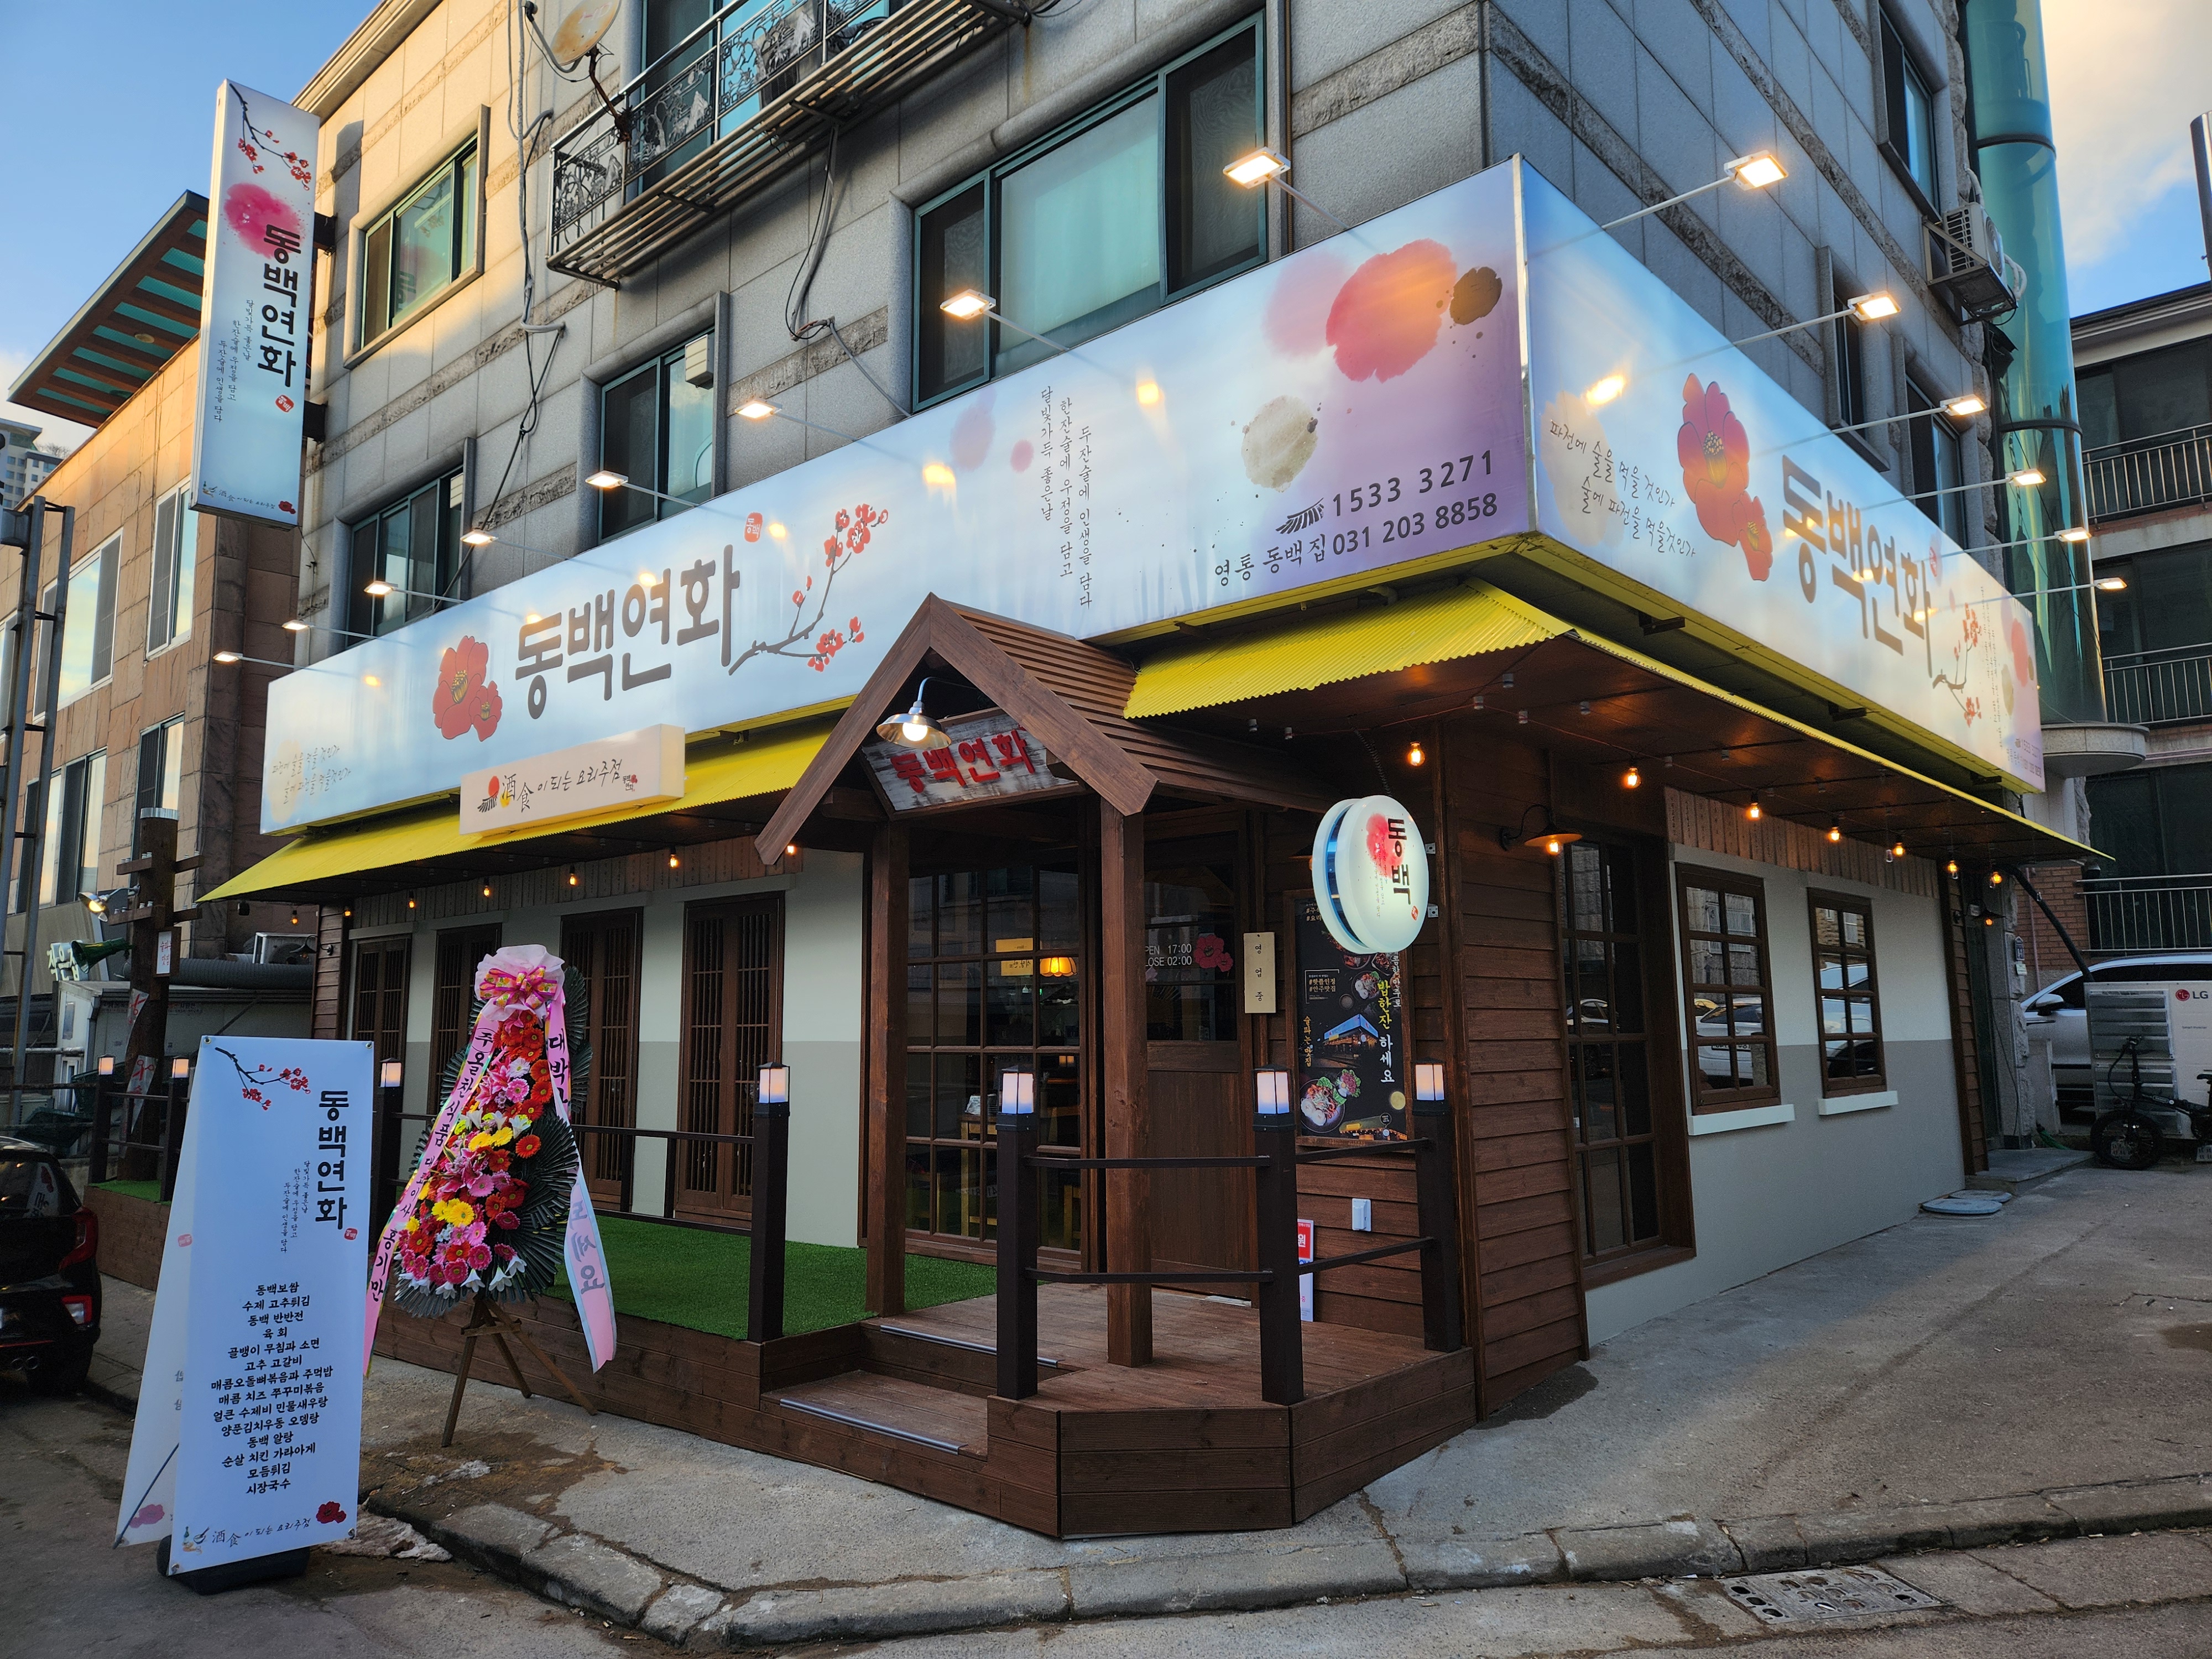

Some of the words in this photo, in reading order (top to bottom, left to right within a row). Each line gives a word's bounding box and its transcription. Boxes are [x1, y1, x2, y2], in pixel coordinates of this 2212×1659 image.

[244, 299, 254, 333] 달빛가득
[257, 223, 302, 388] 동백연화
[231, 320, 241, 353] 한잔술에
[243, 336, 253, 361] 좋은날
[217, 340, 227, 374] 두잔술에
[228, 356, 238, 382] 우정을
[215, 377, 223, 403] 인생을
[228, 384, 237, 401] 담고
[214, 405, 223, 422] 담다
[1041, 385, 1053, 458] 달빛가득
[1060, 397, 1072, 471] 한잔술에
[1078, 426, 1092, 501] 두잔술에
[1550, 419, 1587, 453] 파전에
[1593, 441, 1614, 483] 술을
[1619, 461, 1639, 499] 먹을
[1645, 474, 1675, 508] 것인가
[1041, 466, 1053, 521] 좋은날
[1333, 477, 1401, 517] 1533
[1419, 450, 1491, 494] 3271
[1060, 479, 1072, 535] 우정을
[1582, 476, 1603, 514] 술에
[1609, 498, 1641, 539] 파전을
[746, 518, 761, 539] 동백
[1079, 509, 1092, 565] 인생을
[1333, 526, 1370, 555] 031
[1383, 512, 1425, 543] 203
[1435, 493, 1498, 529] 8858
[1060, 542, 1073, 577] 담고
[1782, 454, 1933, 679] 동백연화
[1079, 572, 1092, 609] 담다
[515, 544, 740, 719] 동백연화
[576, 759, 622, 786] 요리주점
[890, 729, 1035, 794] 동백연화
[1387, 818, 1411, 905] 동백
[1144, 946, 1160, 955] PEN
[1168, 943, 1192, 954] 17:00
[1167, 956, 1192, 966] 02:00
[2192, 990, 2209, 999] LG
[1379, 1034, 1395, 1083] 하세요
[315, 1091, 349, 1230] 동백연화
[282, 1182, 291, 1211] 두잔술에
[290, 1224, 298, 1238] 담고
[280, 1239, 288, 1253] 담다
[255, 1282, 299, 1296] 동백보쌈
[242, 1300, 264, 1312] 수제
[269, 1295, 310, 1308] 고추튀김
[248, 1313, 269, 1326] 동백
[273, 1311, 303, 1323] 반반전
[228, 1344, 260, 1359] 골뱅이
[264, 1340, 296, 1354] 무침과
[299, 1338, 320, 1349] 소면
[244, 1359, 267, 1371] 고추
[270, 1354, 302, 1368] 고갈비
[211, 1370, 299, 1391] 매콤오돌뼈볶음과
[302, 1365, 333, 1379] 주먹밥
[213, 1409, 235, 1422] 얼큰
[239, 1404, 272, 1418] 수제비
[276, 1396, 328, 1413] 민물새우탕
[219, 1392, 241, 1405] 매콤
[245, 1390, 267, 1402] 치즈
[221, 1417, 285, 1437] 양푼김치우동
[288, 1412, 319, 1426] 오뎅탕
[247, 1434, 268, 1448] 동백
[273, 1431, 294, 1444] 알탕
[222, 1453, 244, 1468] 순살
[248, 1450, 268, 1463] 치킨
[273, 1442, 315, 1459] 가라아게
[247, 1462, 290, 1478] 모듬튀김
[246, 1478, 291, 1495] 시장국수
[276, 1518, 311, 1531] 요리주점
